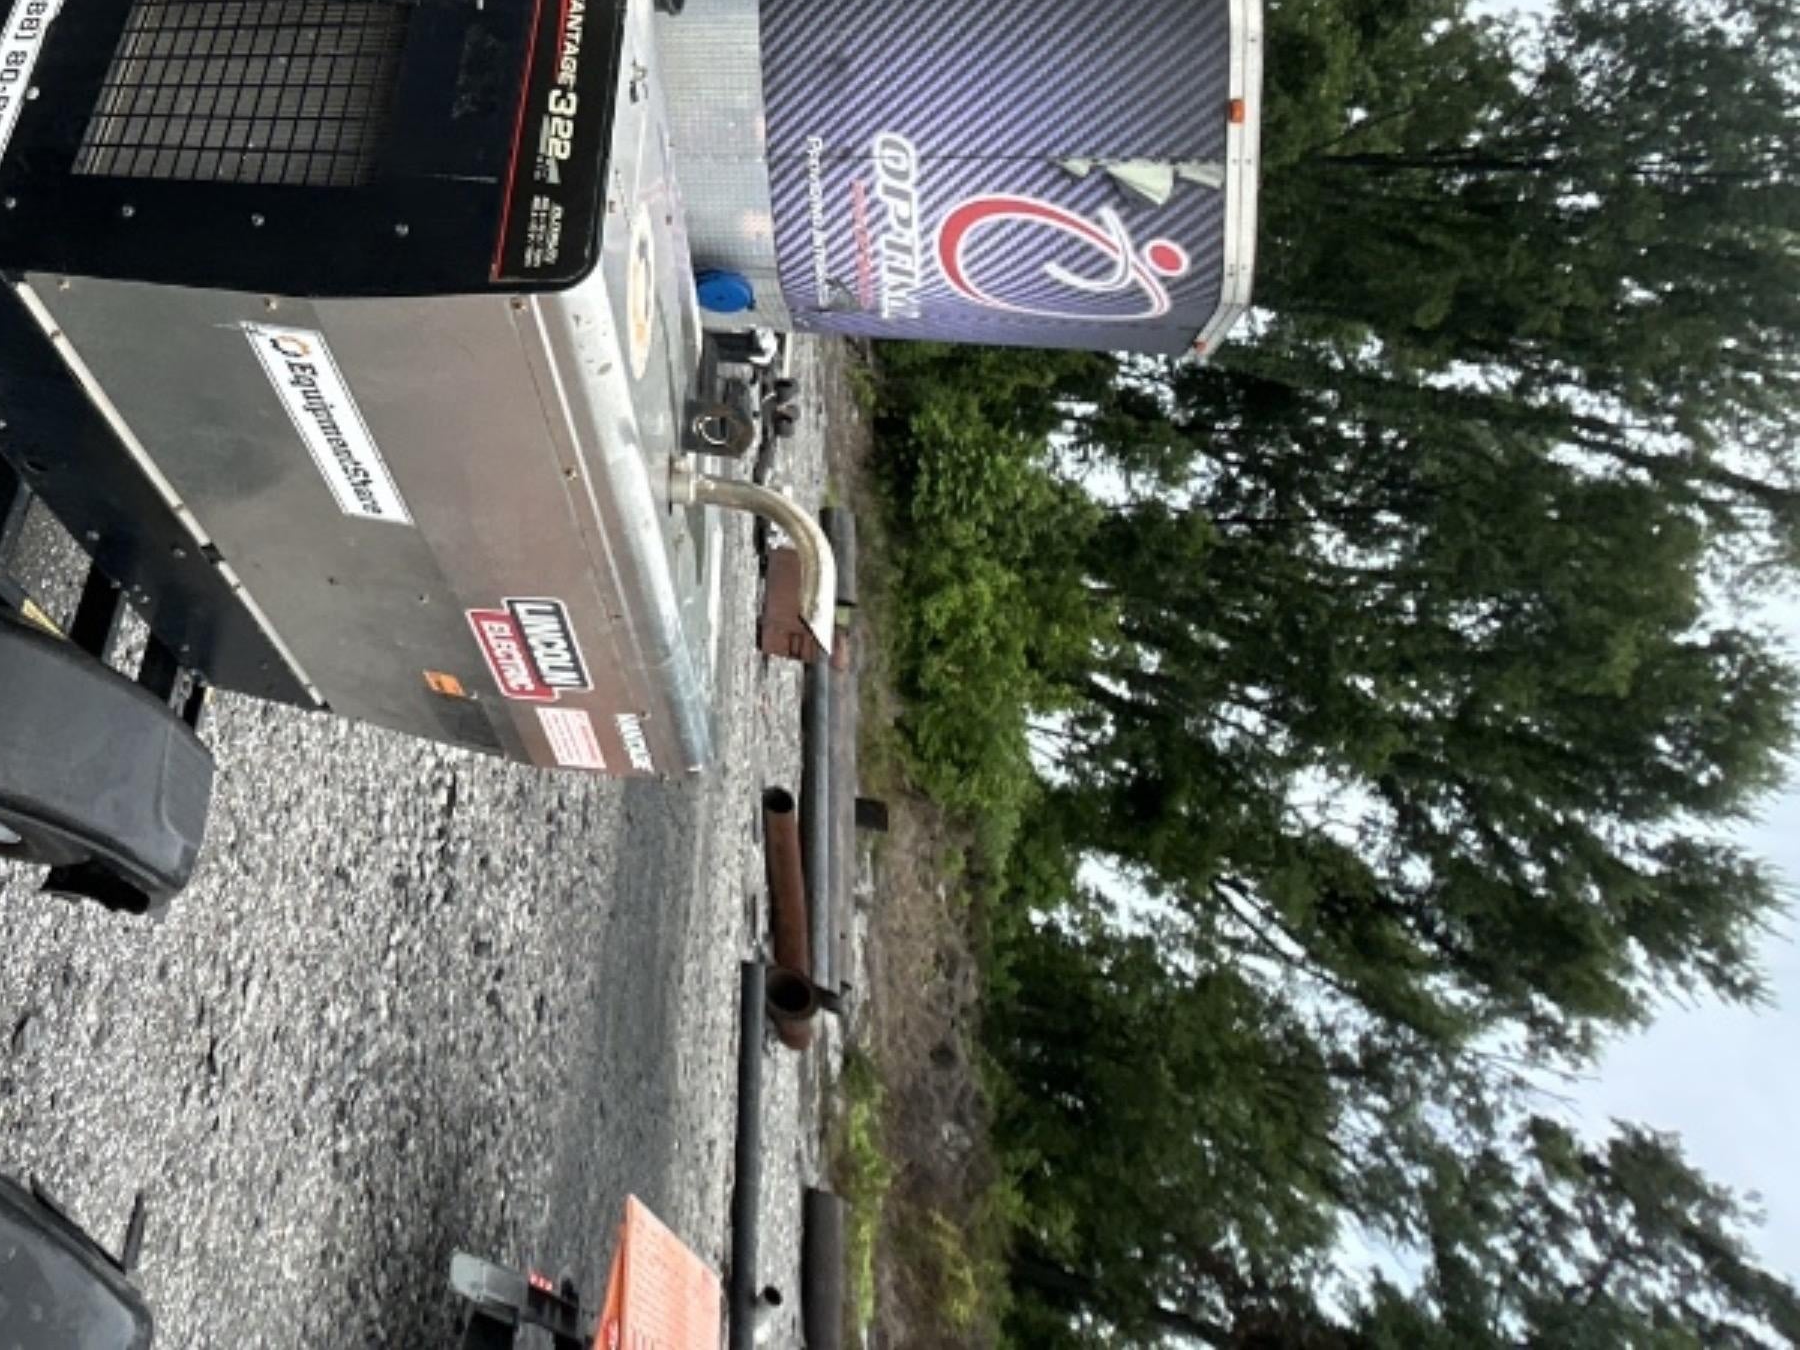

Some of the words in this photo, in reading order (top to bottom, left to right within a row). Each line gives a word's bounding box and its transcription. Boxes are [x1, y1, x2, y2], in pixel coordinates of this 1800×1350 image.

[546, 89, 578, 161] 322
[284, 360, 383, 515] EquipmentShare
[479, 620, 534, 692] ELECTRIC
[513, 602, 582, 687] LINCOLN
